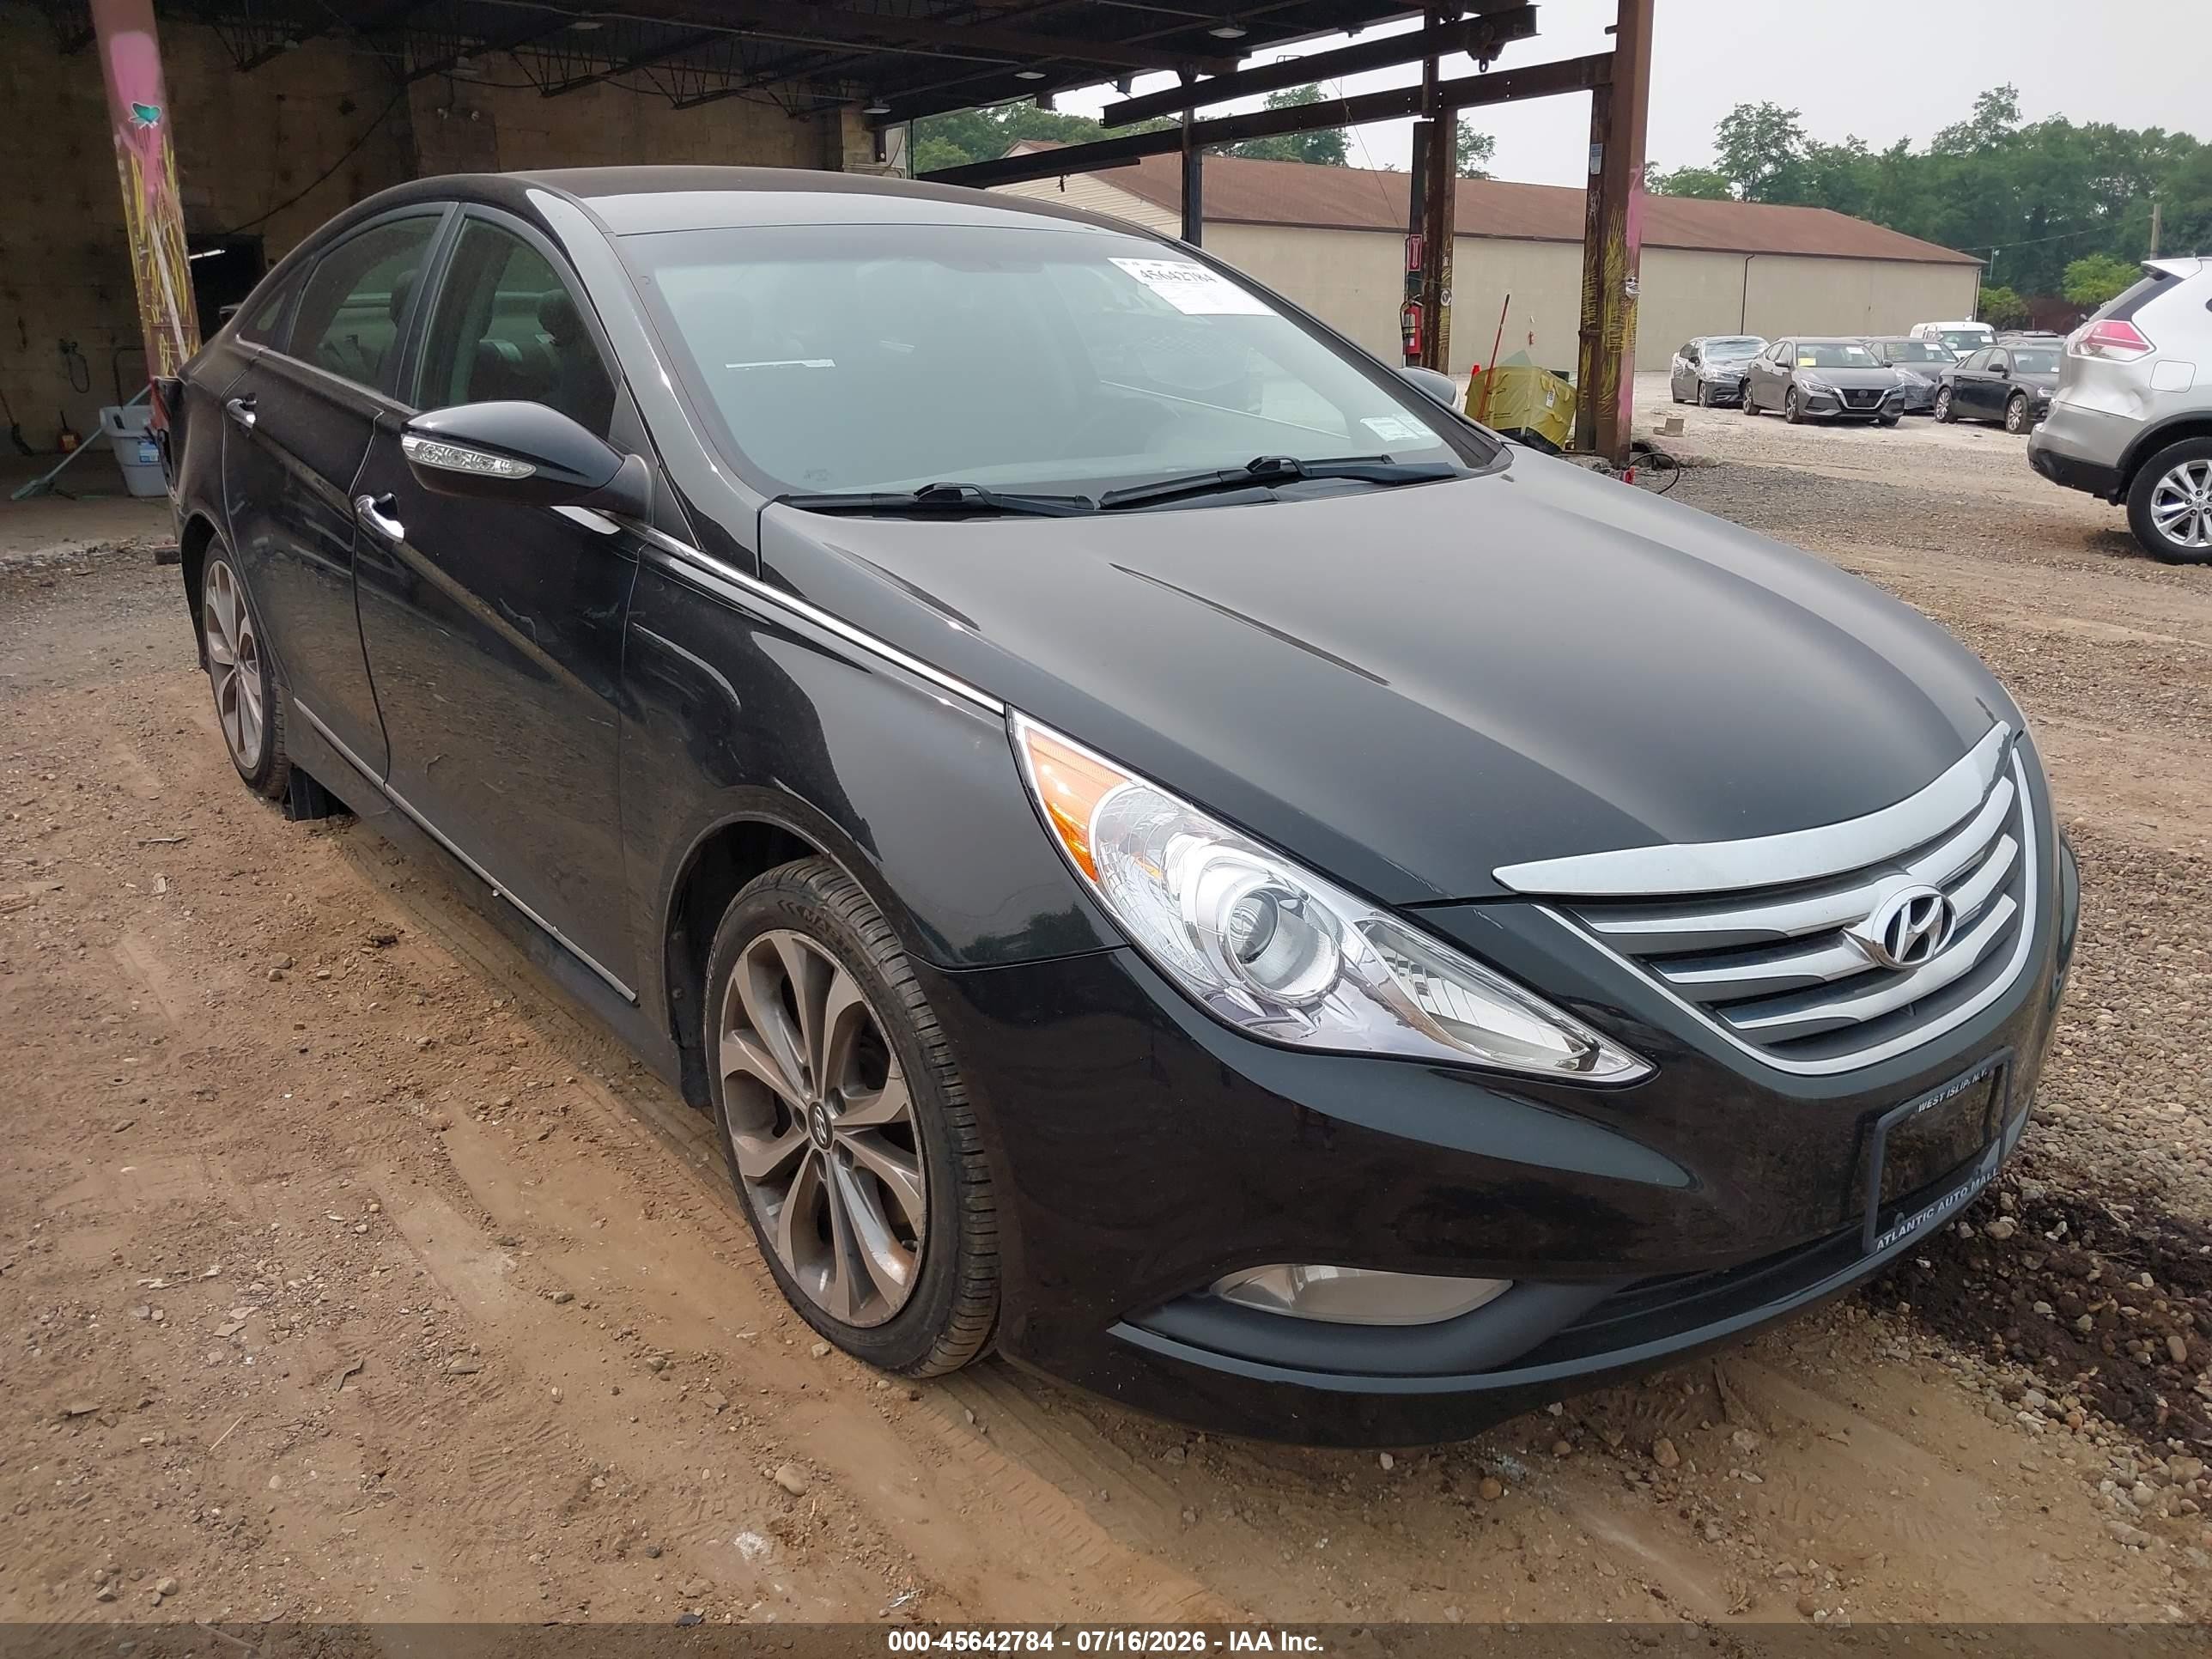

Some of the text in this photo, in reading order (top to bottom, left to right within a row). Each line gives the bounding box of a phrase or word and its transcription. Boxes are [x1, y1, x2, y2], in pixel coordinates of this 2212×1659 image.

[1917, 1091, 1946, 1113] WEST
[1875, 1167, 2000, 1251] ATLANTIC AUTO MALL
